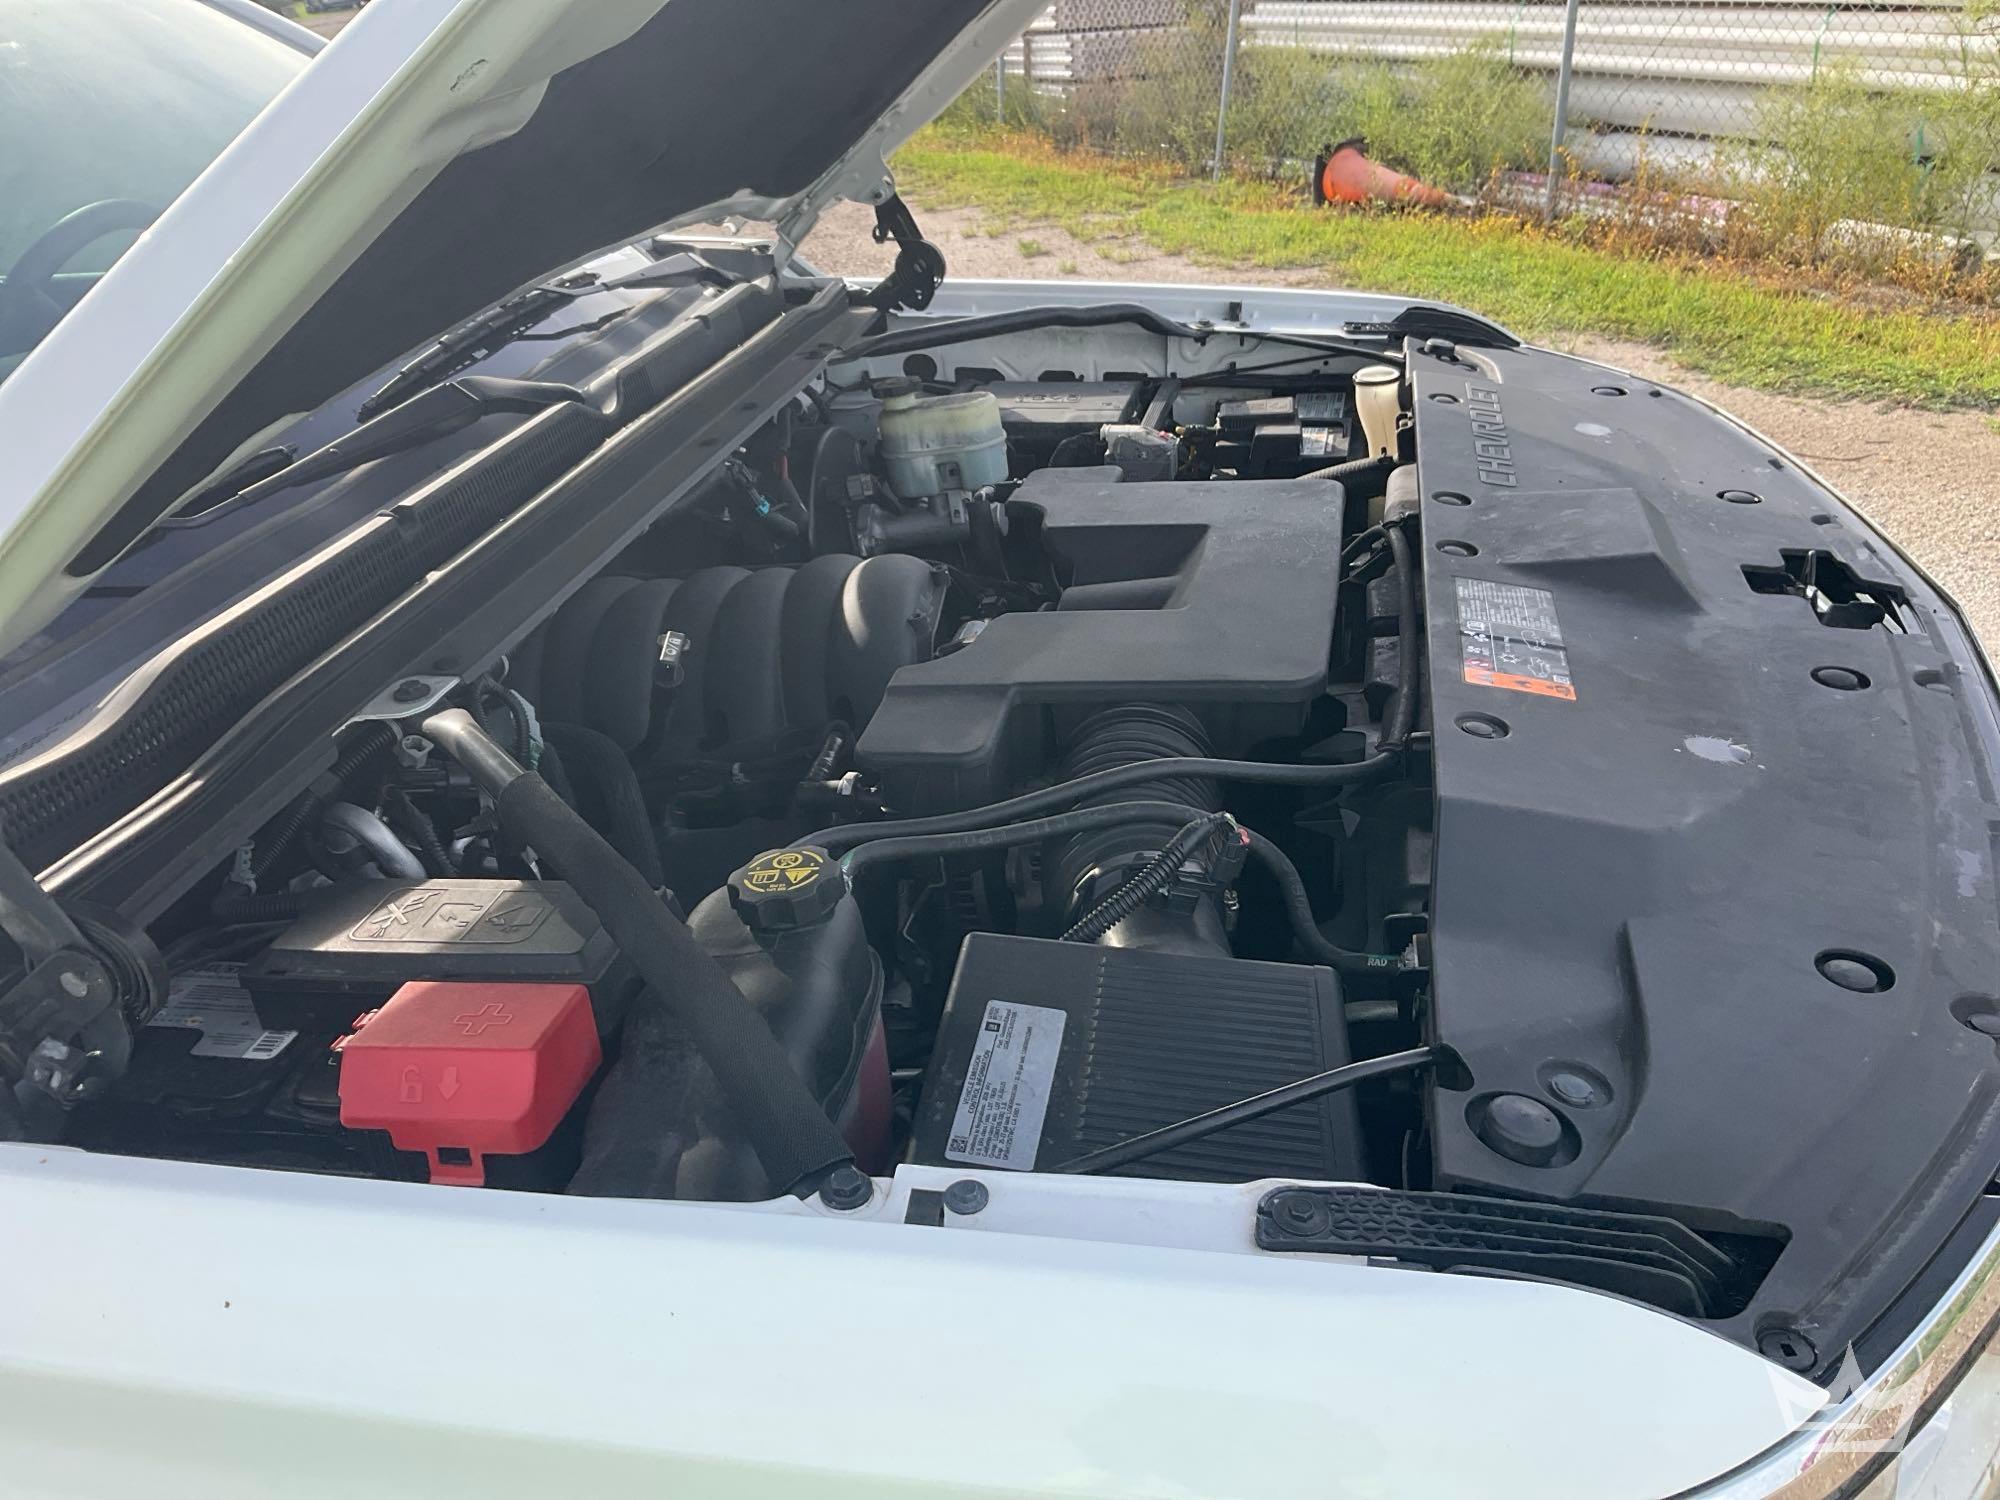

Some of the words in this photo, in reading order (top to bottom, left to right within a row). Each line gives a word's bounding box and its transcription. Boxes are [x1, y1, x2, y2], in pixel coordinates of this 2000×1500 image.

[1466, 382, 1517, 487] CHEVROLET
[1367, 957, 1388, 967] RAD
[962, 1081, 975, 1104] VEHICLE
[969, 1055, 982, 1080] EMISSION
[967, 1086, 981, 1113] CONTROL
[975, 1050, 990, 1086] INFORMATION
